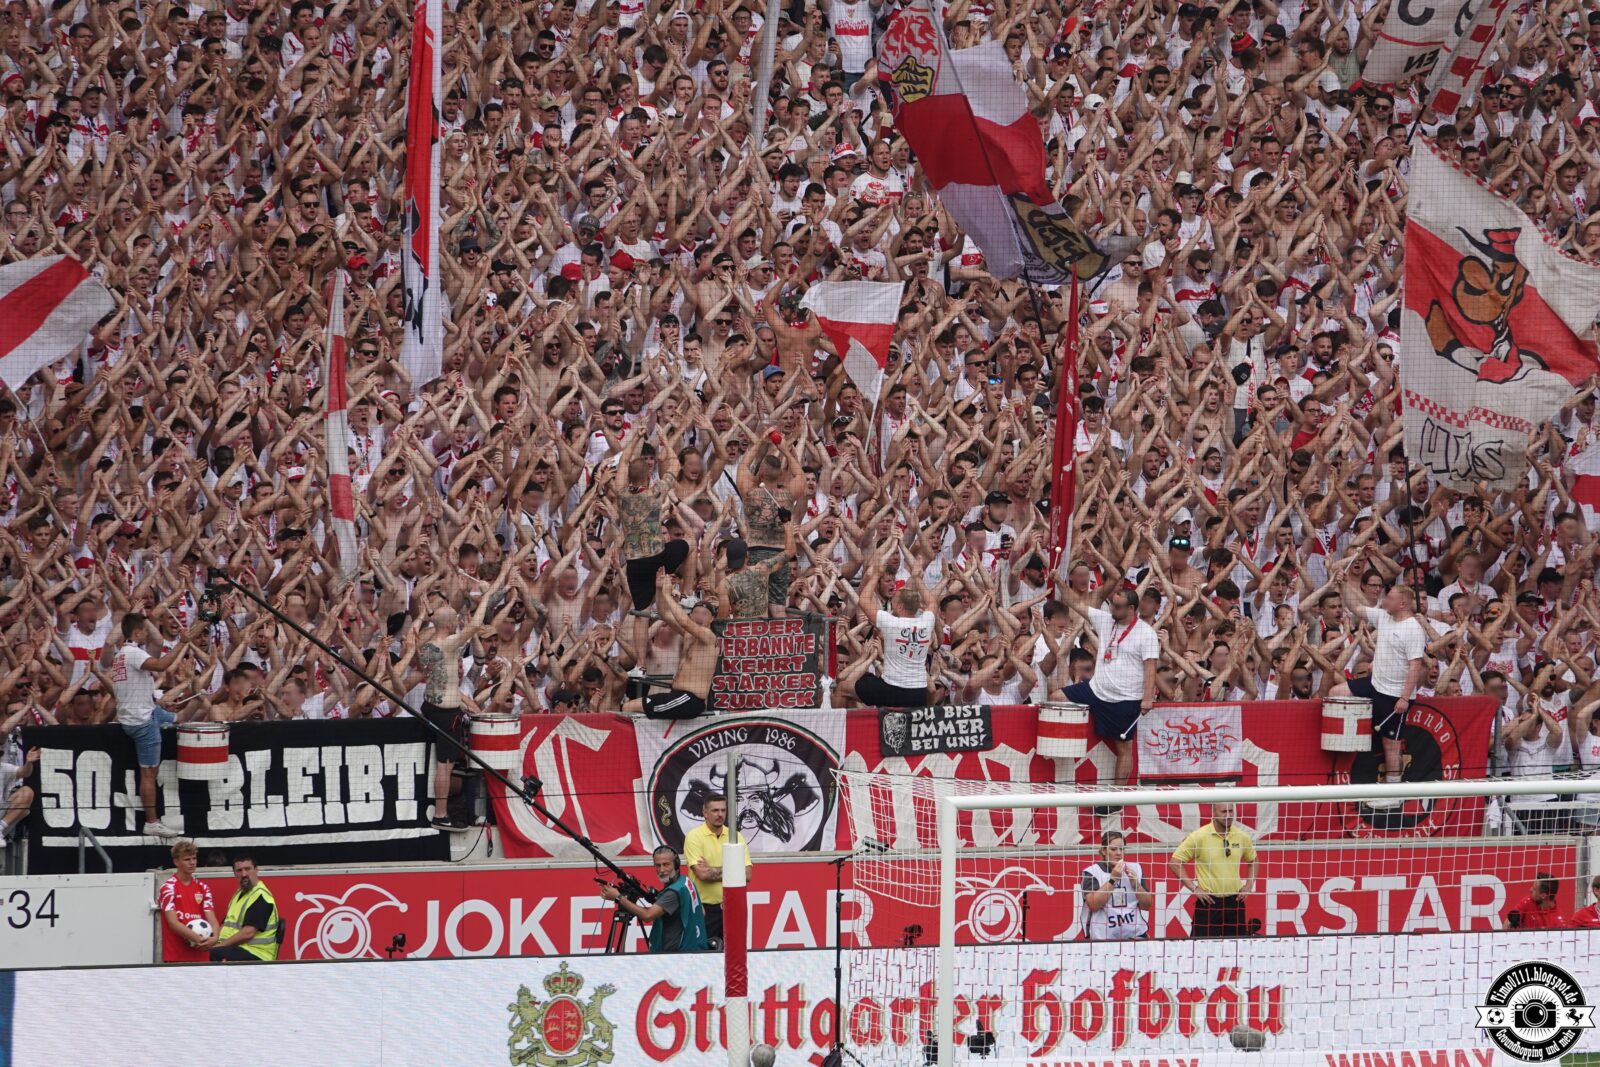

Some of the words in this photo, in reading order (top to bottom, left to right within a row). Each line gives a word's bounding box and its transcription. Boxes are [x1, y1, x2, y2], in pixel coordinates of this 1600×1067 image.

[723, 619, 804, 638] JEDER
[722, 655, 806, 673] KEHRT
[714, 691, 815, 708] ZURÜCK
[911, 707, 936, 722] DU
[943, 705, 982, 718] BIST
[911, 719, 985, 738] IMMER
[688, 727, 748, 758] VIKING
[765, 728, 796, 750] 1986
[911, 738, 940, 751] BEI
[946, 734, 987, 749] UNS!
[40, 748, 185, 835] 50+1
[7, 888, 60, 930] 34
[1053, 874, 1508, 941] JKRSTAR
[406, 889, 875, 957] JOKETAR
[1020, 966, 1287, 1058] Hofbräu
